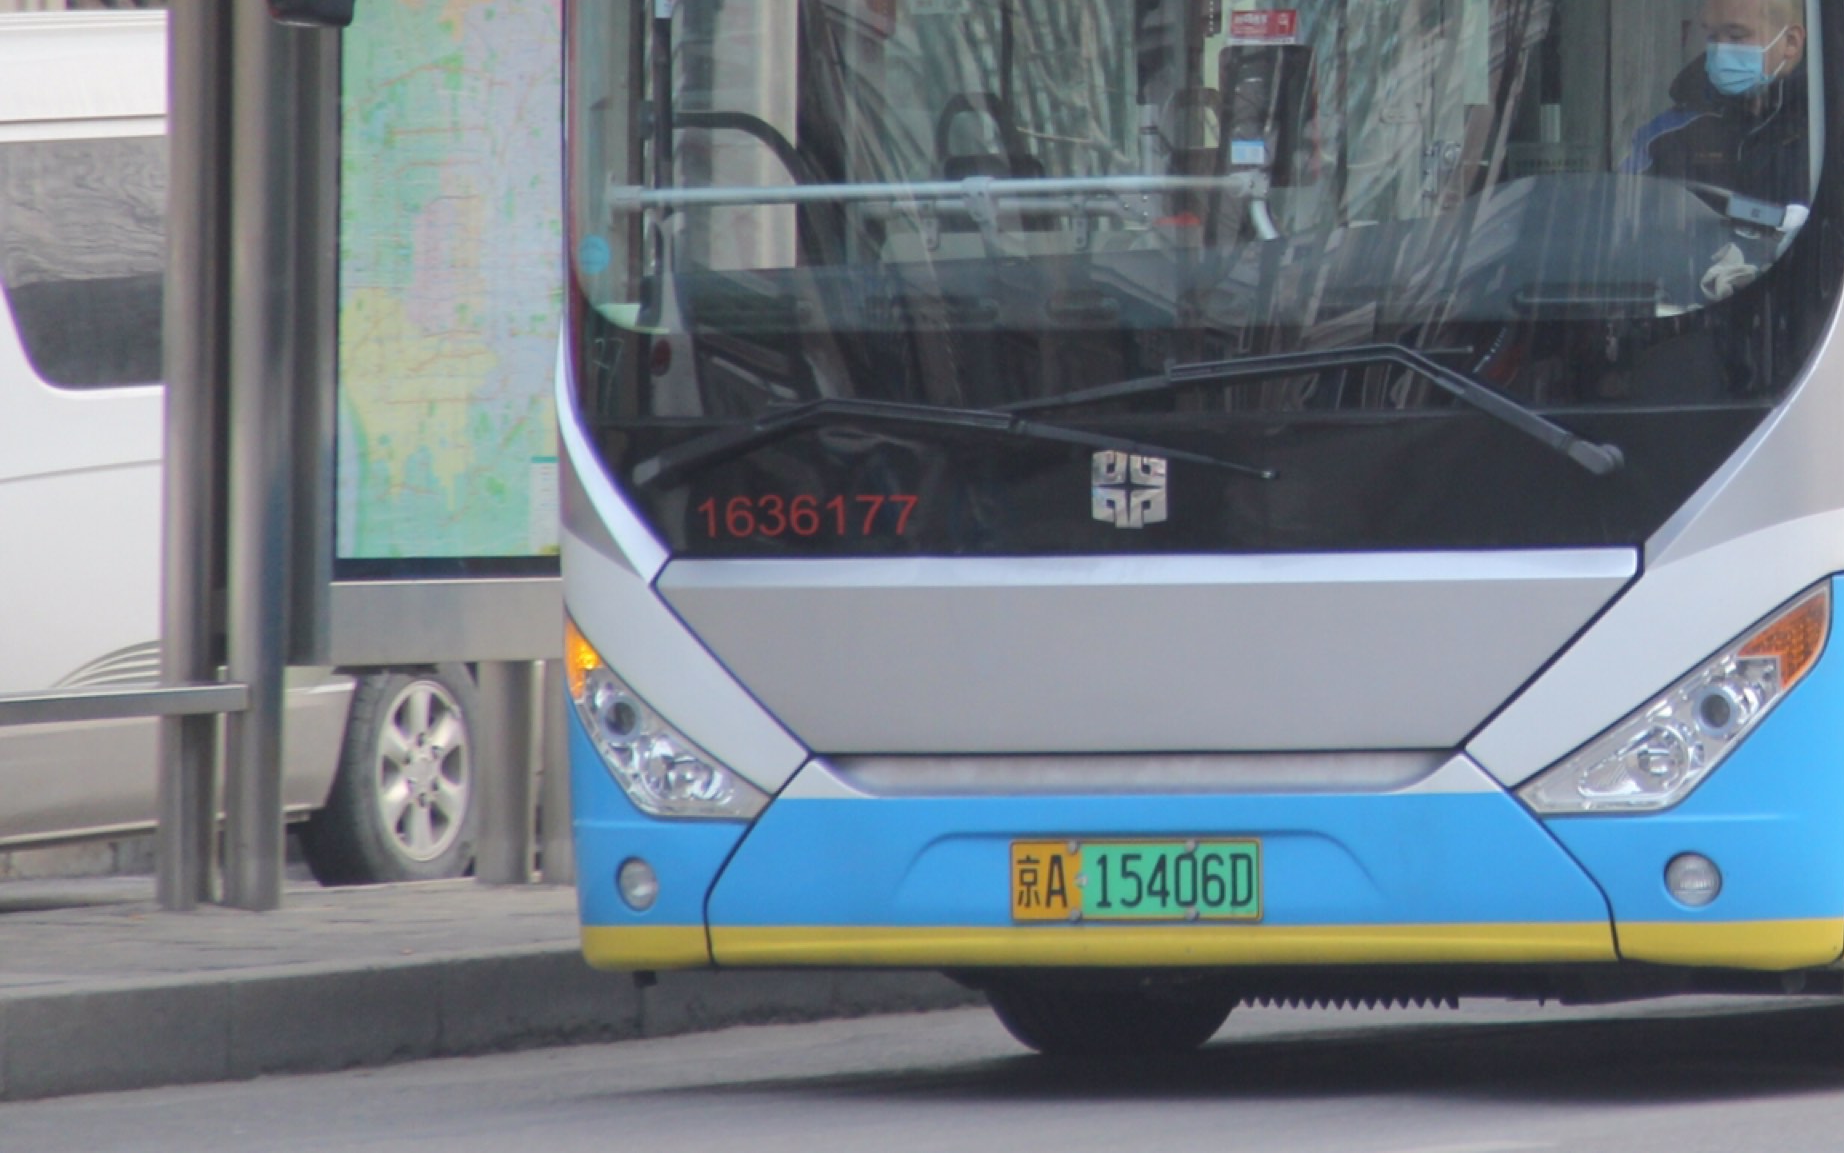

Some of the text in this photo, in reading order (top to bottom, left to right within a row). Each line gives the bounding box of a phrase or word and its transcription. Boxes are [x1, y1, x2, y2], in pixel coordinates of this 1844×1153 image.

[697, 494, 919, 538] 1636177
[1017, 853, 1254, 909] 京A 15406D
